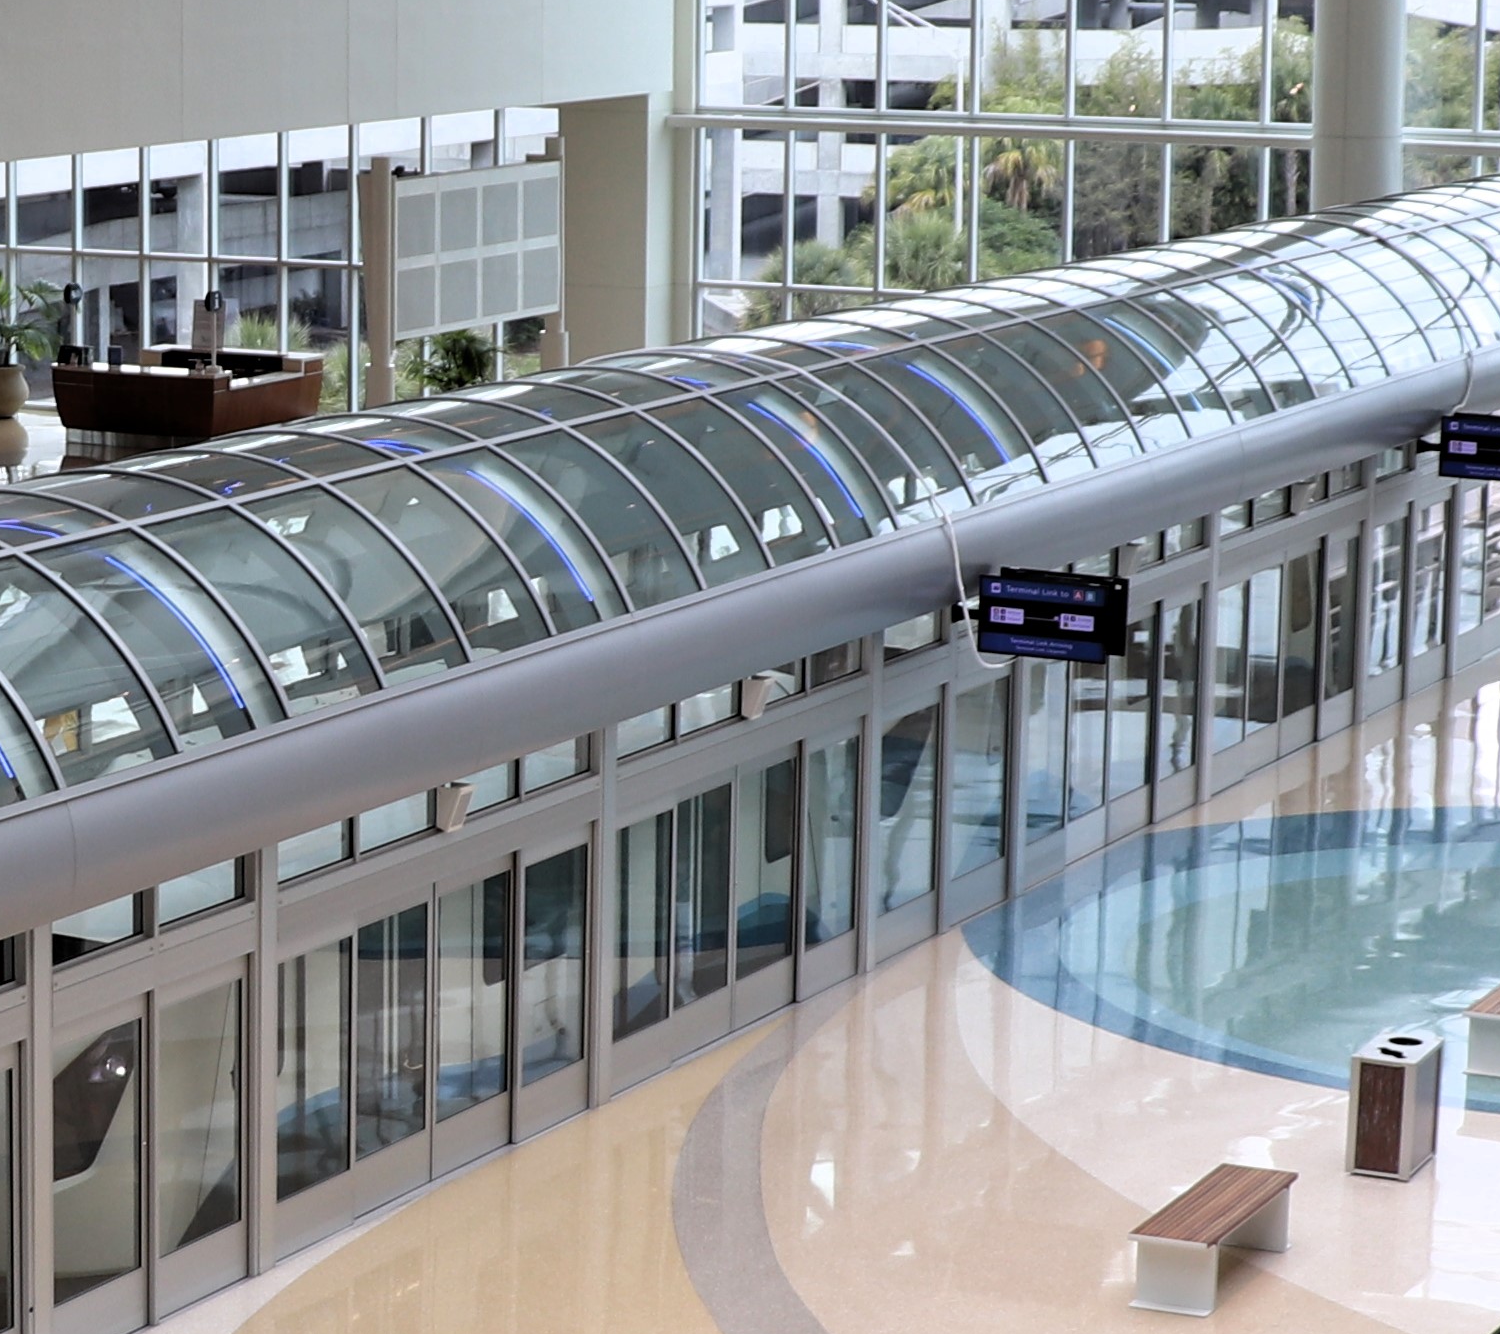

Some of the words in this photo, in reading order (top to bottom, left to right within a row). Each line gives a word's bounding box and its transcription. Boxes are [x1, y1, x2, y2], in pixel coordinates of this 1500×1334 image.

[1006, 584, 1041, 596] Terminal
[1042, 588, 1058, 596] Link
[1060, 590, 1069, 598] to
